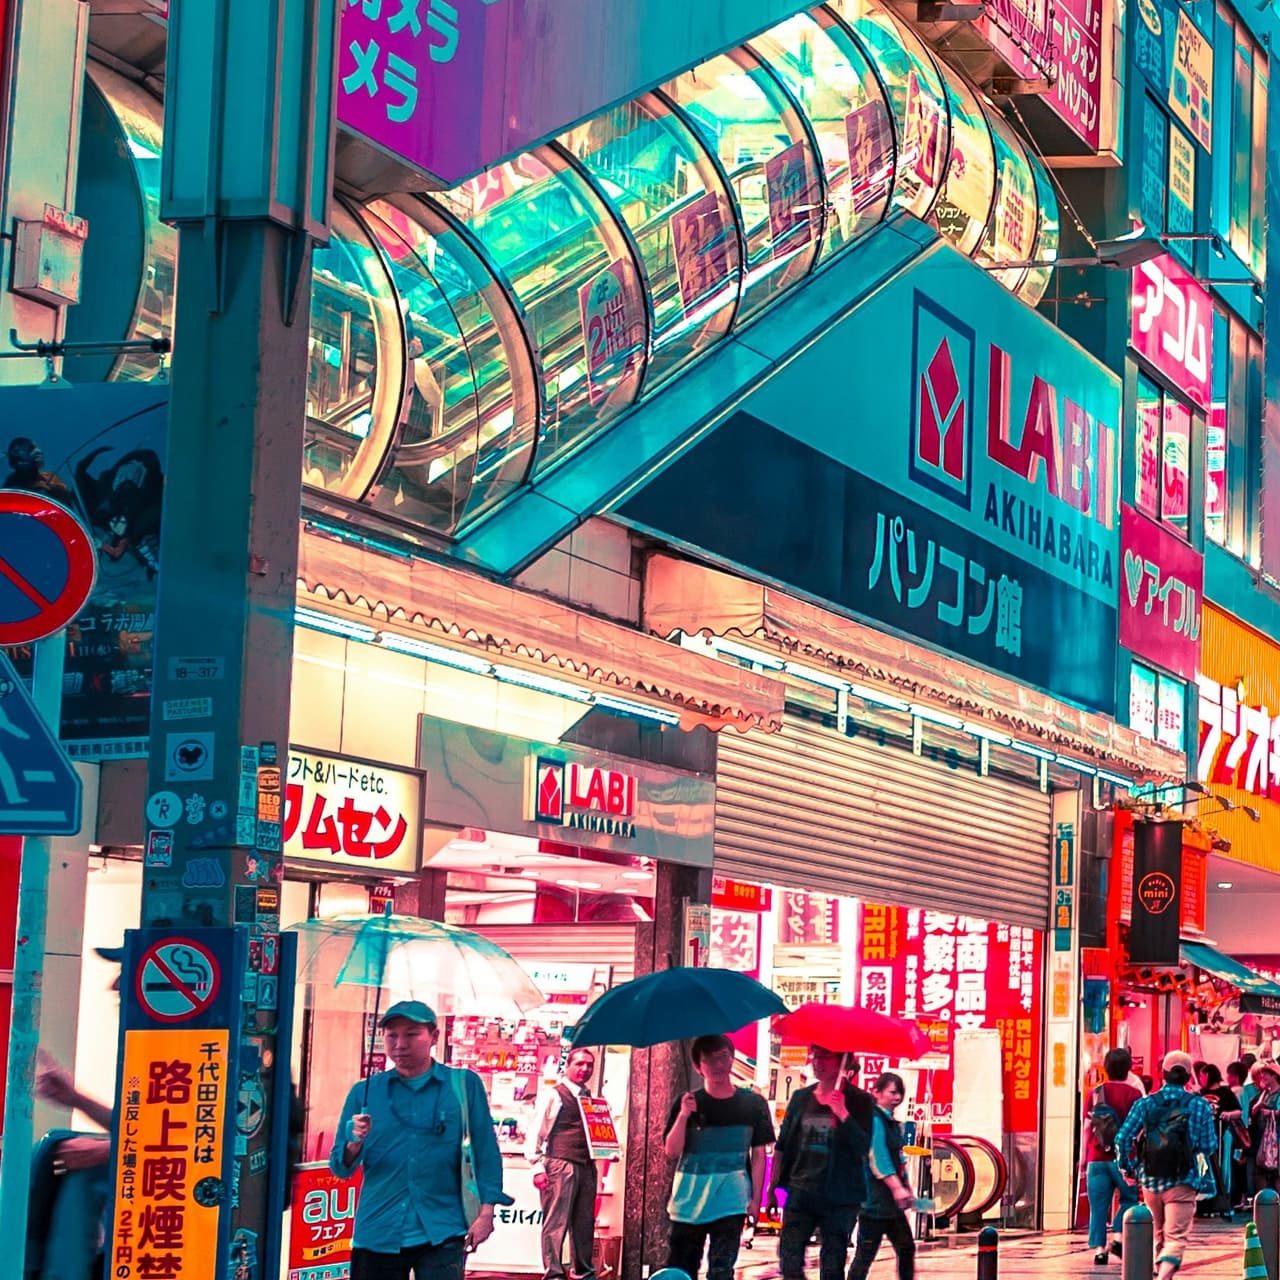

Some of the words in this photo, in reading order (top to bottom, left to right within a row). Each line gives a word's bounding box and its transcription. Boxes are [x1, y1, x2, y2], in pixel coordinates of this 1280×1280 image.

[988, 343, 1113, 531] LABI
[985, 482, 1113, 589] AKIHABARA
[868, 512, 1024, 658] パソコン館
[1144, 558, 1200, 642] アイフル
[570, 763, 635, 816] LABI
[568, 813, 637, 839] AKIHABARA
[1144, 888, 1168, 899] mini
[194, 1041, 221, 1164] 千代田区内は
[303, 1187, 355, 1223] au
[311, 1223, 346, 1241] フェア
